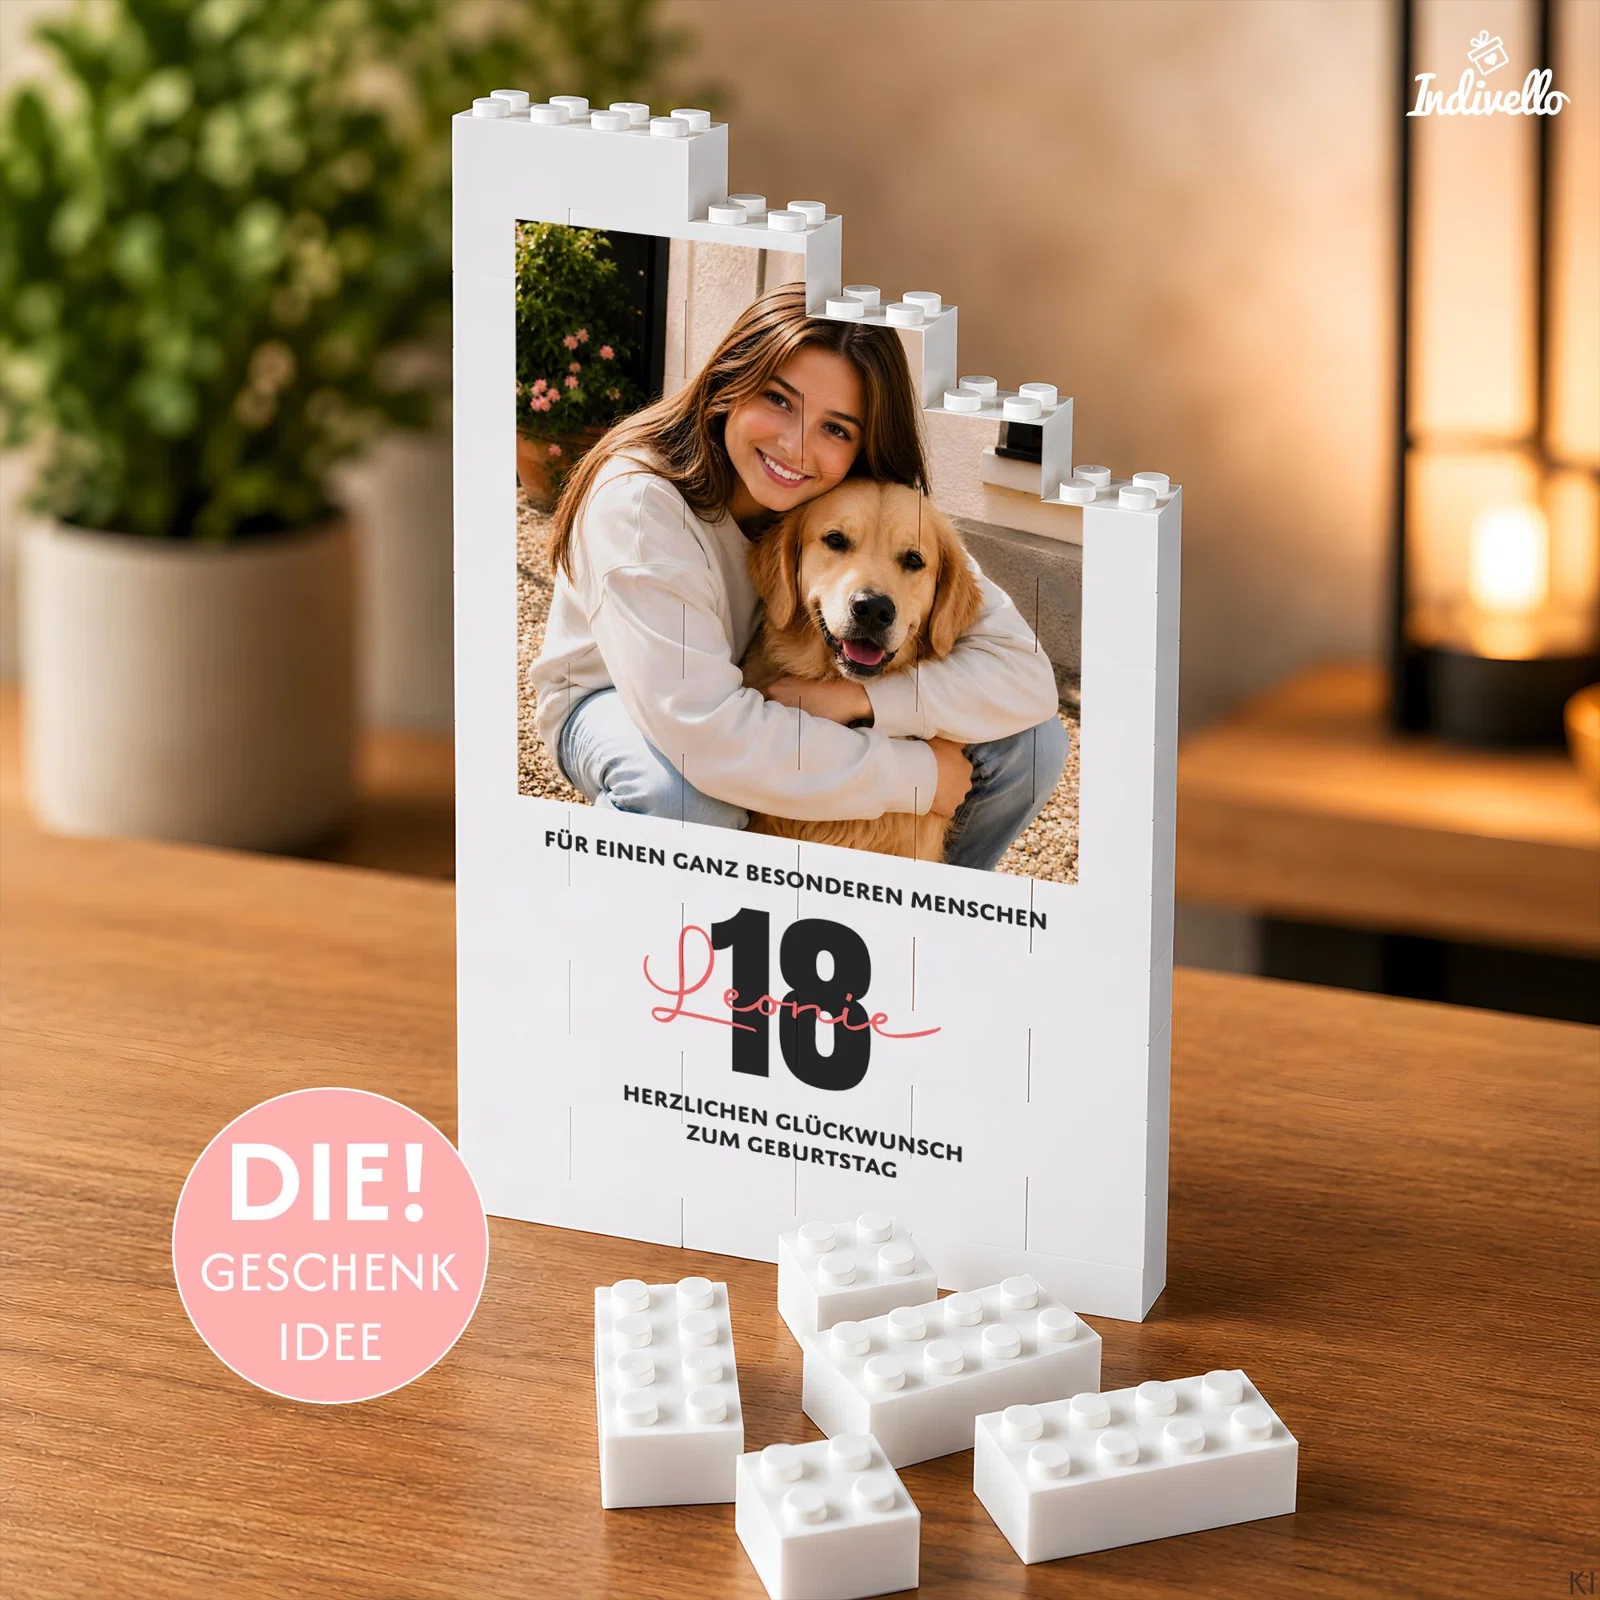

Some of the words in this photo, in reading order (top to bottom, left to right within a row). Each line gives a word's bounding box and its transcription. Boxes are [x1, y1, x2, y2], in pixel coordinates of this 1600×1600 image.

[544, 829, 590, 855] FÜR
[596, 839, 666, 867] EINEN
[673, 852, 739, 878] GANZ
[746, 863, 903, 906] BESONDEREN
[911, 891, 1048, 930] MENSCHEN
[643, 924, 942, 1039] Leonie
[711, 907, 872, 1092] 18
[623, 1084, 768, 1127] HERZLICHEN
[775, 1113, 964, 1163] GLÜCKWUNSCH
[686, 1124, 741, 1150] ZUM
[747, 1135, 898, 1179] GEBURTSTAG
